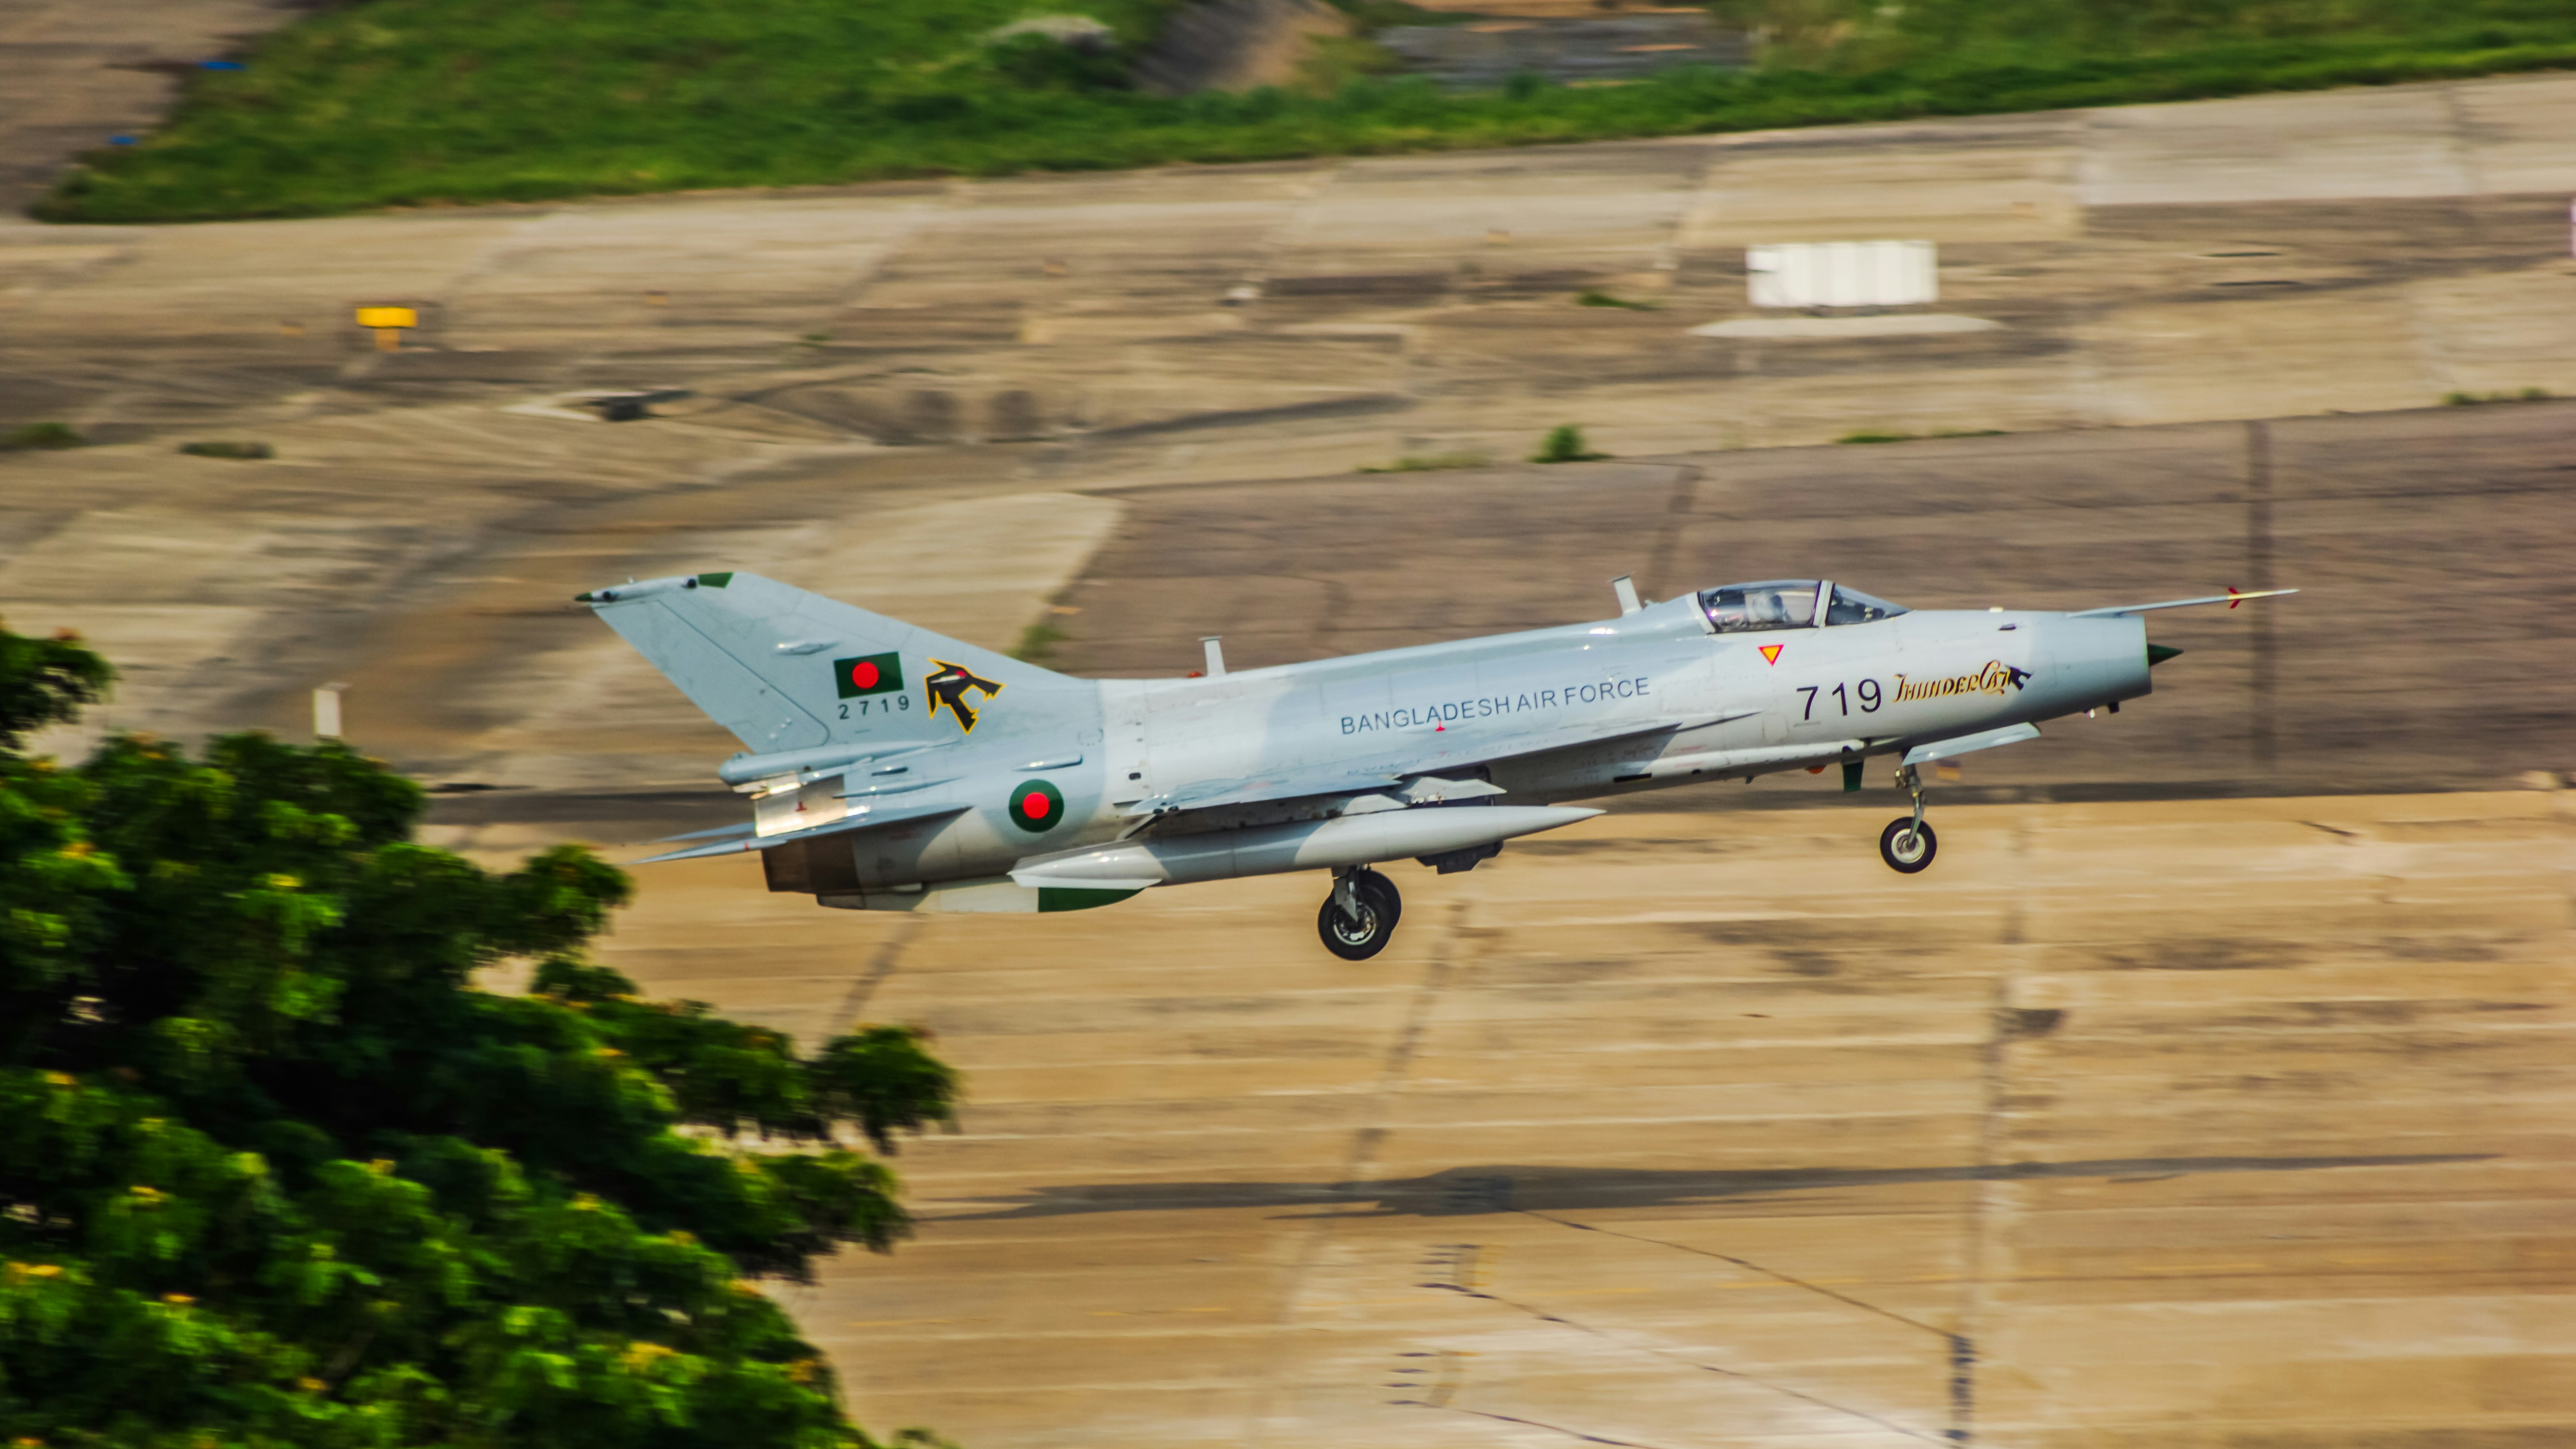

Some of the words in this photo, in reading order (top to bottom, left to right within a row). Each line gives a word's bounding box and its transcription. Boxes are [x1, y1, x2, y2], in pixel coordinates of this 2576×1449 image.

[838, 695, 909, 720] 2719
[1341, 696, 1510, 735] BANGLADESH
[1517, 690, 1557, 713] AIR
[1564, 677, 1651, 706] FORCE
[1796, 679, 1881, 721] 719
